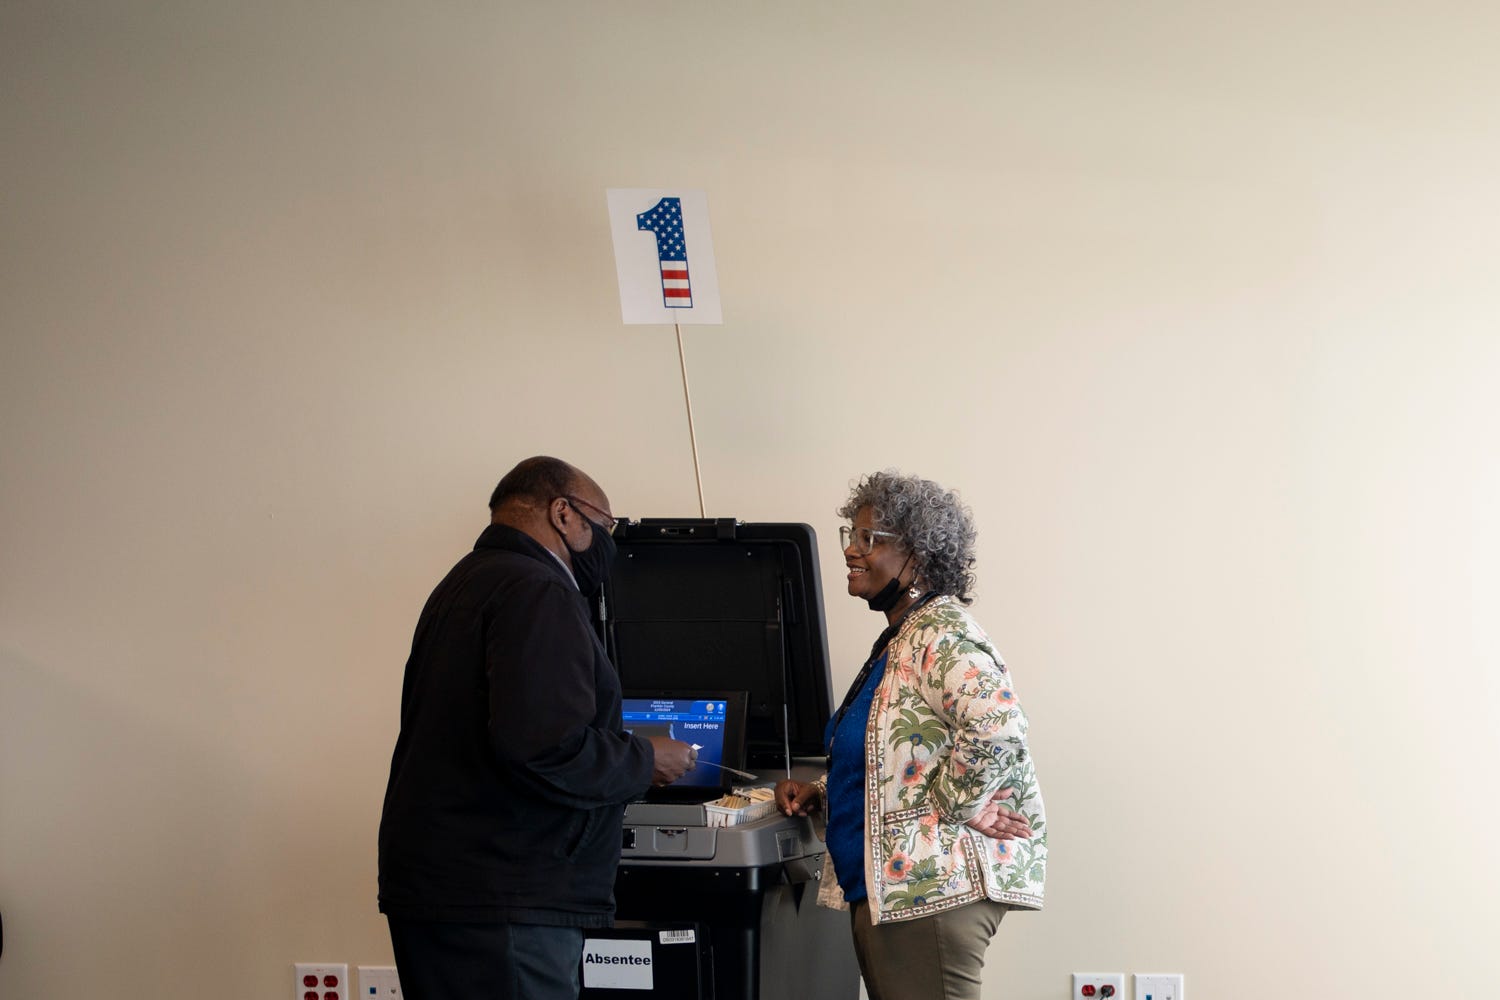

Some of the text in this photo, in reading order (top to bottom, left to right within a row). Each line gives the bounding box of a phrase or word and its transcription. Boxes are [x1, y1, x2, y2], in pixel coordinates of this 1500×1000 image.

[636, 197, 693, 308] 1
[684, 722, 719, 730] Insert Here
[585, 953, 651, 965] Absentee
